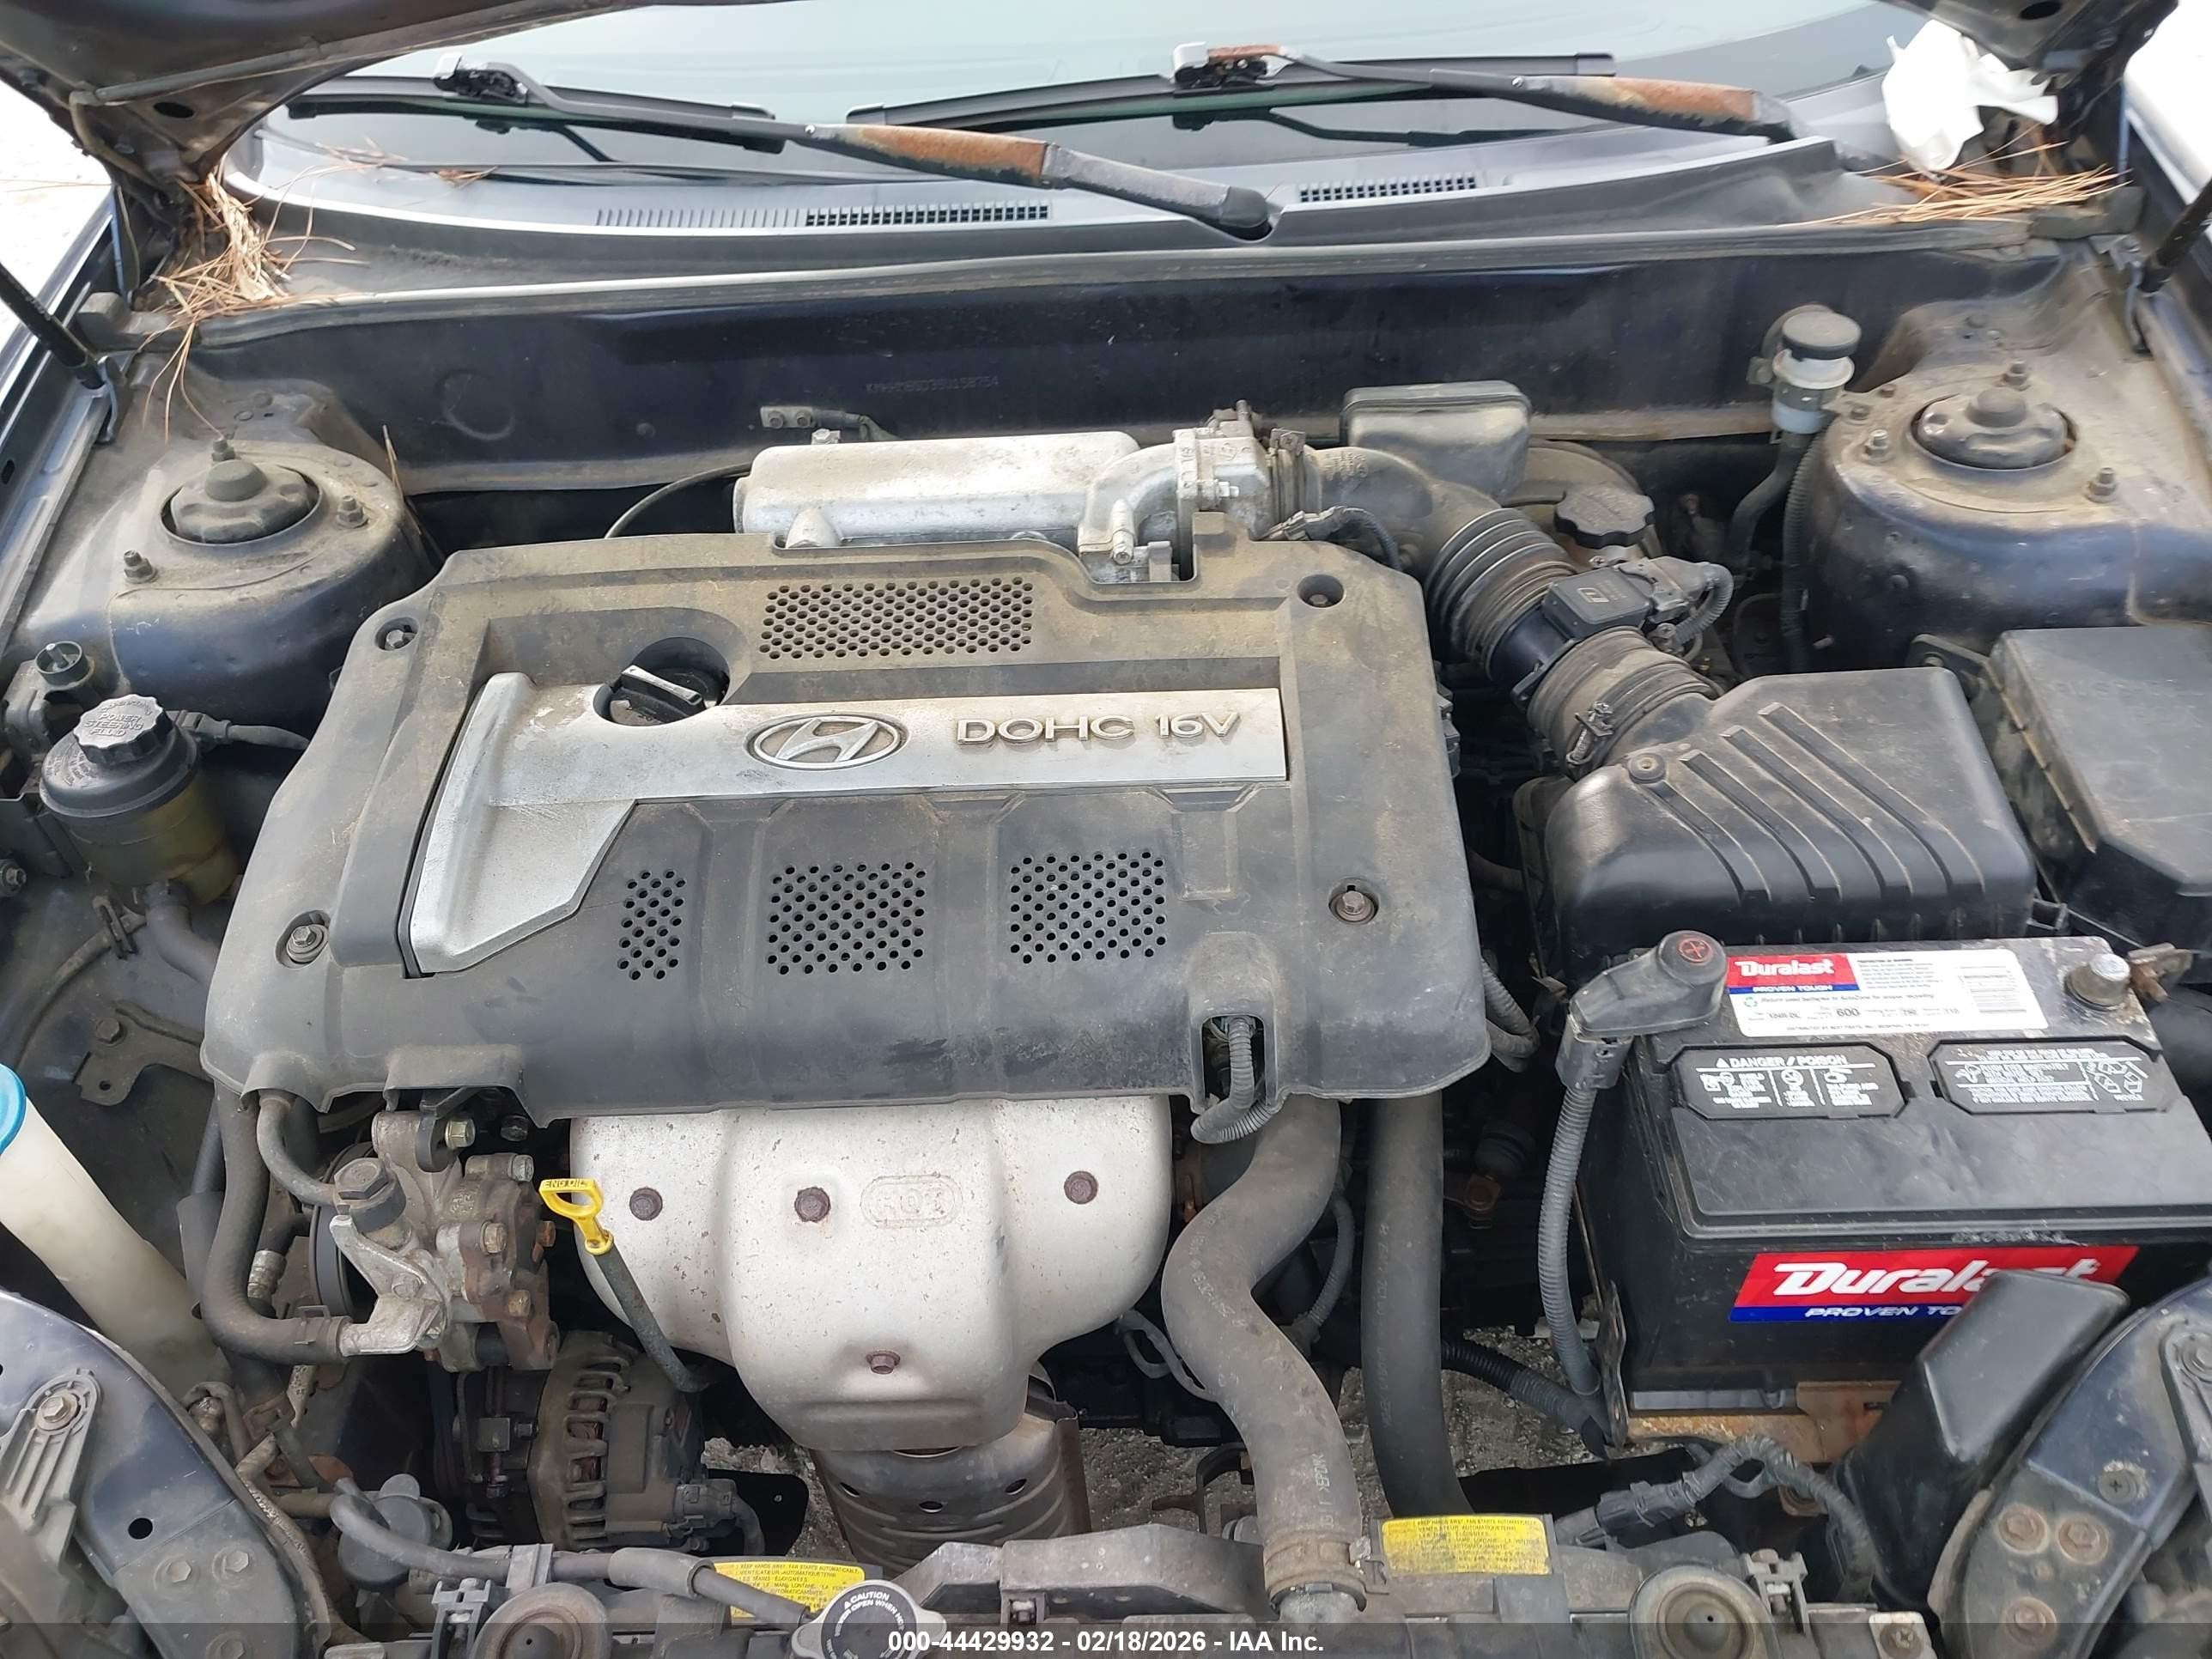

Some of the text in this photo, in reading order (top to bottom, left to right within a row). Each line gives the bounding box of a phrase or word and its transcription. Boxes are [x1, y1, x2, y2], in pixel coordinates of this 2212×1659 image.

[99, 713, 143, 722] POWER
[84, 720, 144, 731] STEERING
[957, 712, 1240, 744] DOHC 16V
[90, 727, 127, 737] FLUID
[1735, 958, 1835, 977] Duralast
[1836, 1007, 1862, 1018] 600
[1729, 1056, 1785, 1067] DANGER
[1796, 1054, 1848, 1066] POISON
[544, 1178, 587, 1188] ENG OIL
[1774, 1259, 2100, 1296] Duralt
[1804, 1306, 1919, 1318] PROVEN
[850, 1590, 890, 1604] CAUTION
[851, 1599, 874, 1613] OPEN
[875, 1599, 898, 1615] WHEN
